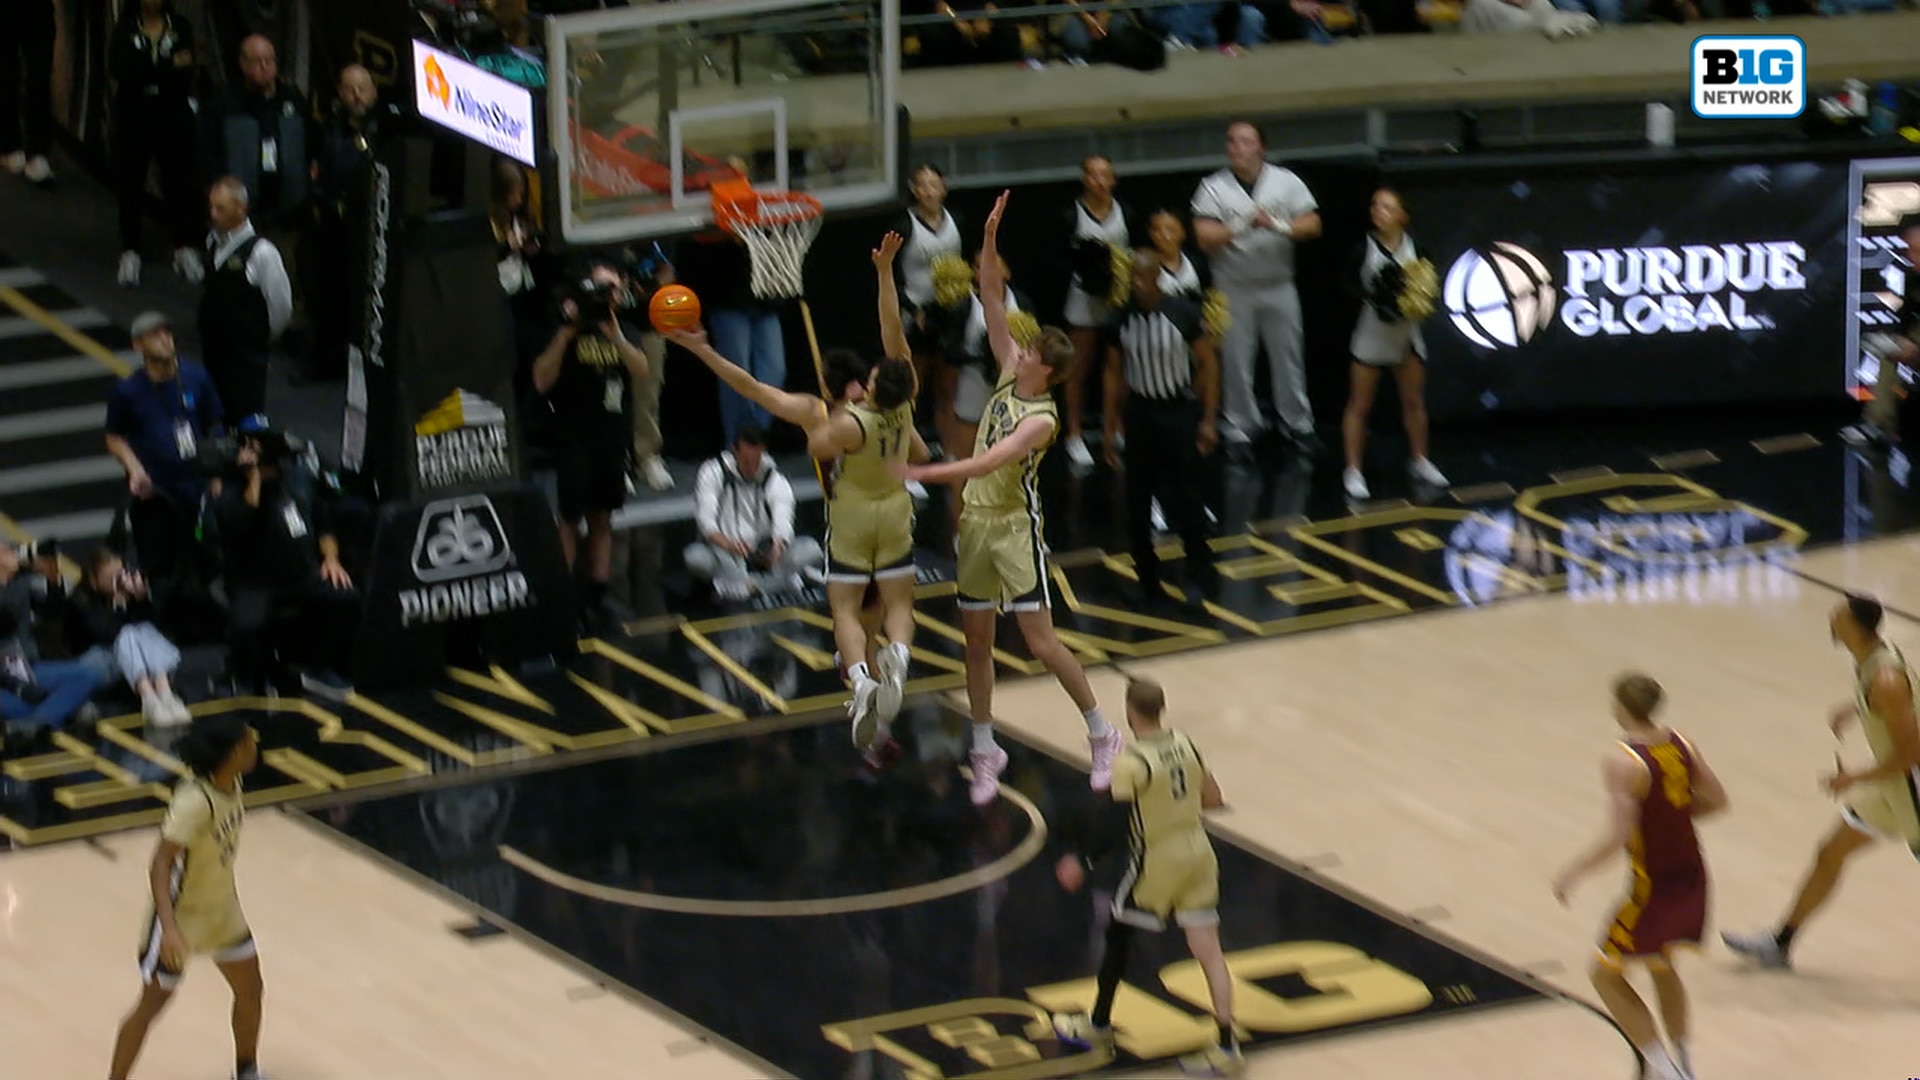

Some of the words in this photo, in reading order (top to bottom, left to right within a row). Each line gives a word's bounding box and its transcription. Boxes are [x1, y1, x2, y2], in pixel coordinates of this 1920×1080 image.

[1562, 240, 1806, 298] PURDUE
[1560, 291, 1764, 338] GLOBAL
[399, 571, 528, 628] PIONEER
